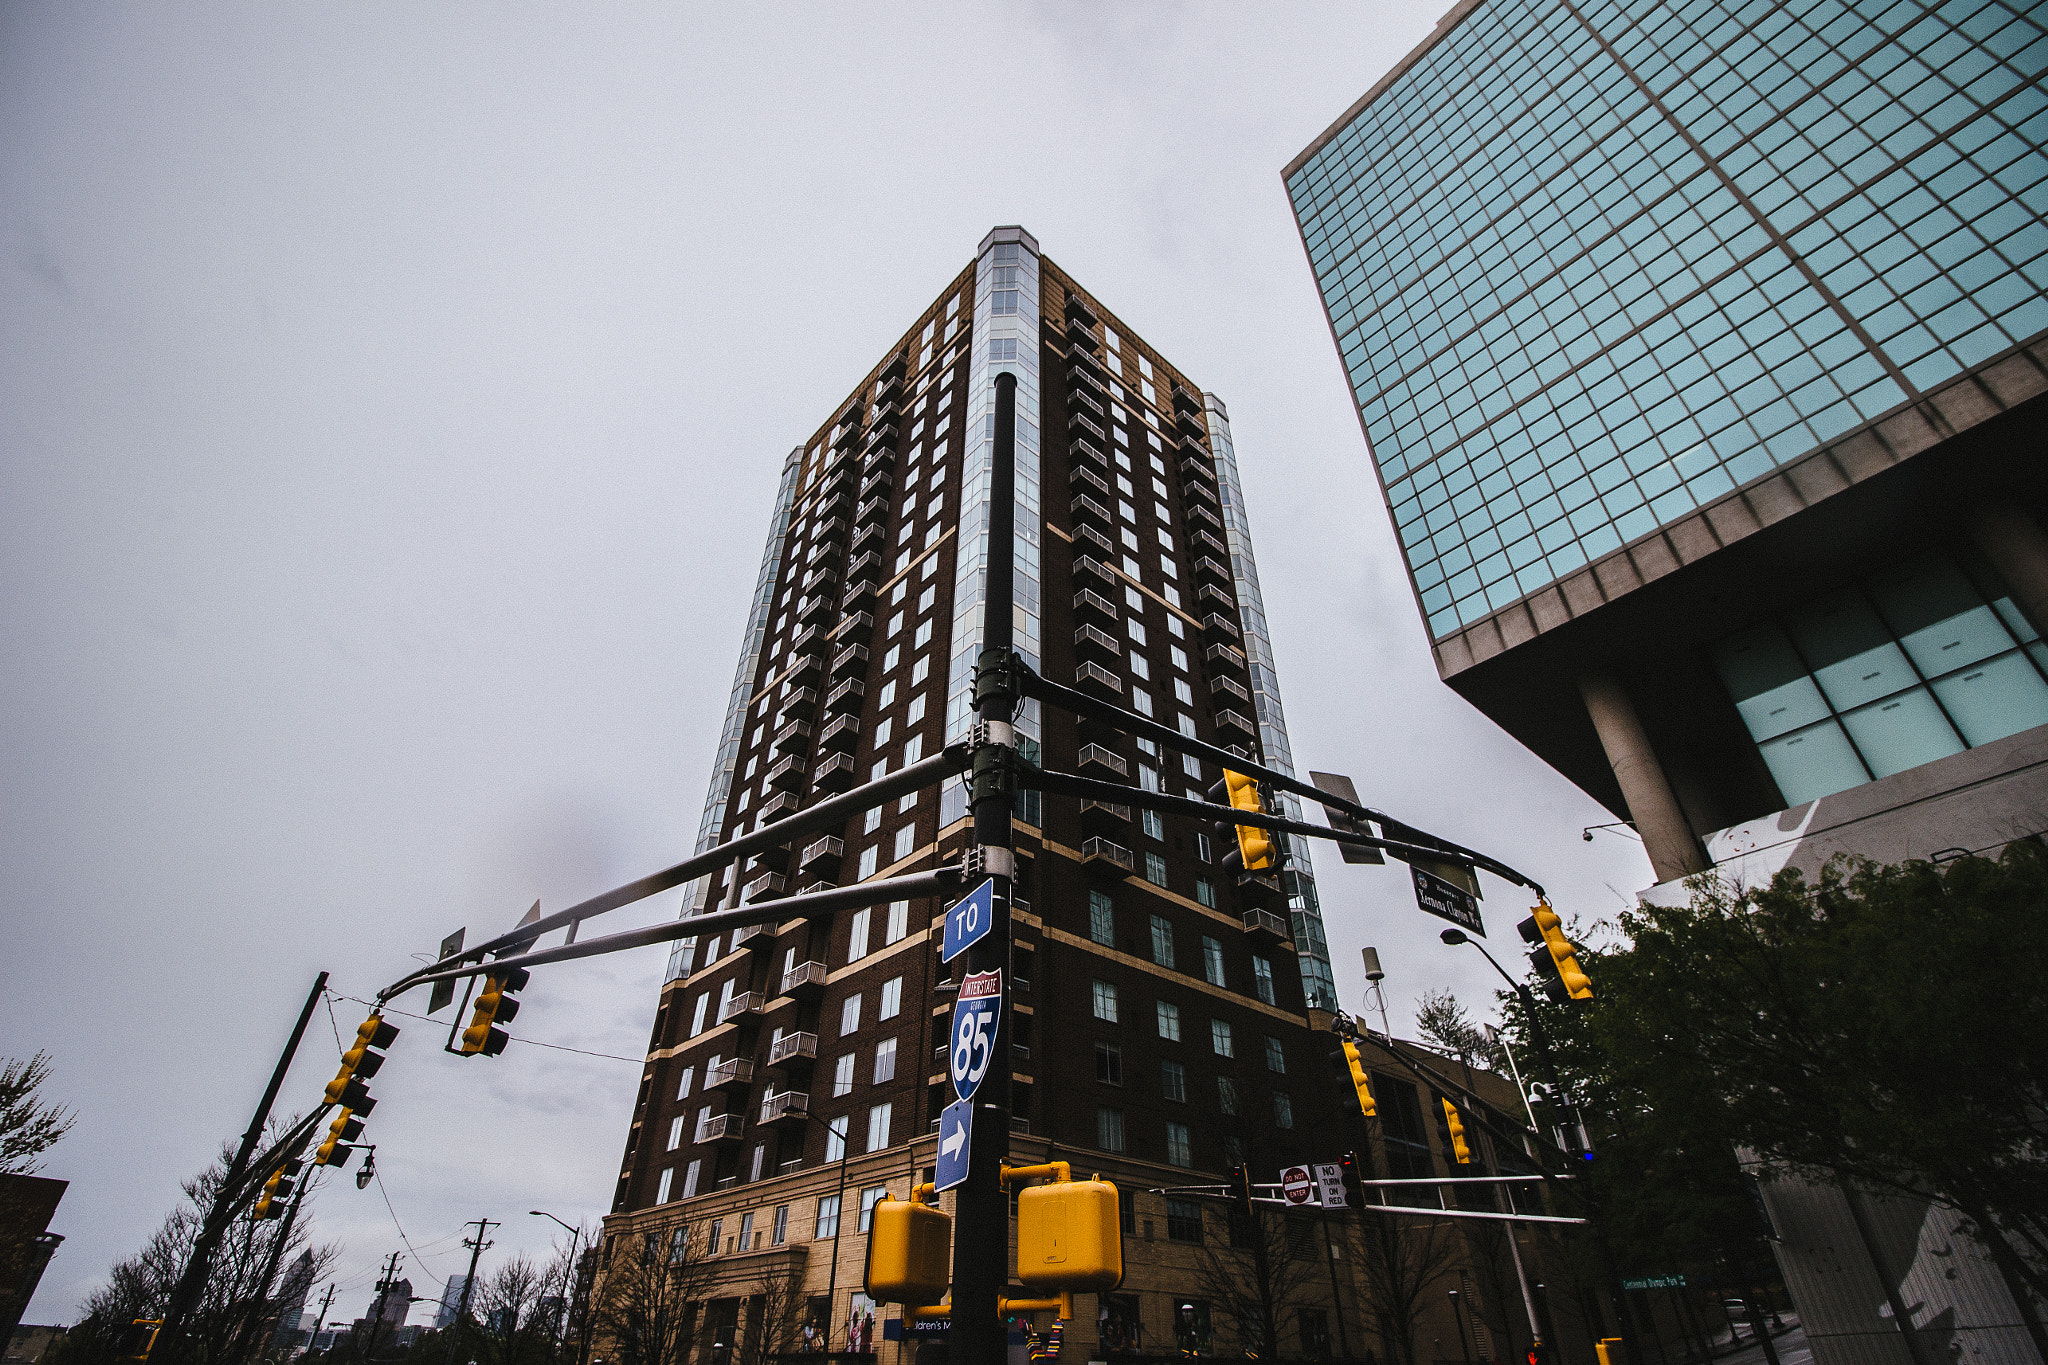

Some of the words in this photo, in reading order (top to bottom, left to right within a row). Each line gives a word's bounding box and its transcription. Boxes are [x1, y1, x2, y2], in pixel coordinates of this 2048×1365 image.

[955, 902, 978, 941] TO
[964, 978, 998, 996] INTERSTATE
[970, 1000, 987, 1011] GEORGIA
[953, 1012, 993, 1083] 85
[1321, 1166, 1335, 1176] NO
[1285, 1175, 1293, 1183] DO
[1294, 1172, 1305, 1181] NOT
[1321, 1178, 1341, 1186] TURN
[1290, 1188, 1307, 1198] ENTER
[1328, 1187, 1339, 1196] ON
[1328, 1197, 1343, 1205] RED
[912, 1320, 942, 1330] ldren's
